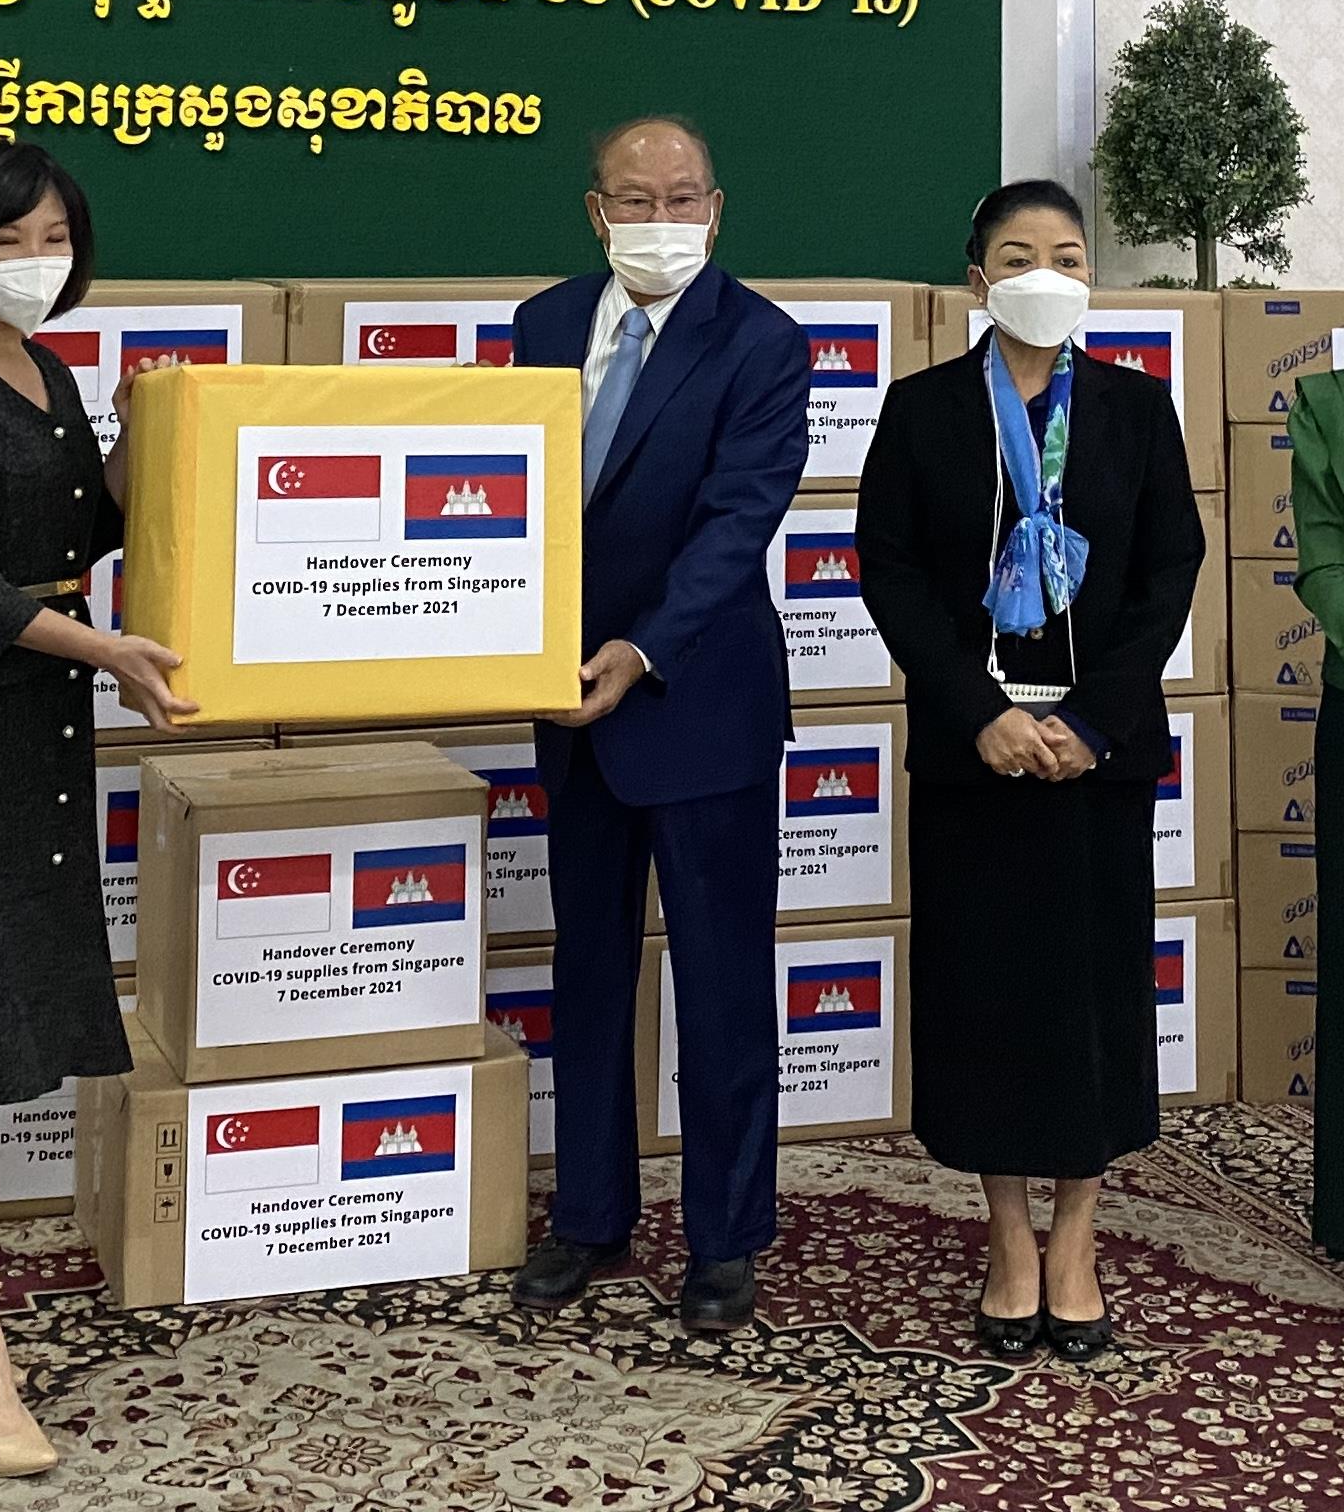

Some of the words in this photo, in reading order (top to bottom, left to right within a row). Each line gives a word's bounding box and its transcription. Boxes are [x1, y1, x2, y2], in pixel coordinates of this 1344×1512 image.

[818, 415, 878, 430] Singapore
[809, 435, 826, 444] 021
[306, 555, 387, 570] Handover
[390, 554, 472, 571] Ceremony
[252, 580, 328, 595] COVID-19
[332, 578, 400, 597] supplies
[404, 577, 443, 591] from
[447, 576, 527, 594] Singapore
[322, 604, 332, 617] 7
[336, 601, 419, 617] December
[422, 600, 458, 614] 2021
[777, 611, 836, 621] eremony
[785, 627, 815, 639] from
[818, 627, 877, 640] Singapore
[799, 645, 826, 657] 2021
[786, 846, 816, 858] from
[818, 844, 879, 858] Singapore
[495, 866, 547, 881] Singapo
[800, 863, 827, 876] 2021
[102, 876, 138, 886] erem
[121, 913, 136, 925] 20
[262, 945, 337, 961] Handover
[339, 939, 415, 955] Ceremony
[212, 969, 283, 986] COVID-19
[286, 964, 349, 983] supplies
[352, 962, 388, 975] from
[391, 956, 465, 974] Singapore
[277, 989, 286, 1003] 7
[290, 984, 366, 1001] December
[368, 980, 402, 995] 2021
[787, 1062, 817, 1075] from
[820, 1059, 881, 1074] Singapore
[800, 1079, 828, 1092] 2021
[13, 1109, 76, 1124] Handove
[35, 1126, 75, 1144] suppl
[26, 1150, 35, 1163] 7
[39, 1150, 73, 1161] Dece
[251, 1198, 325, 1215] Handover
[328, 1190, 404, 1207] Ceremony
[201, 1223, 271, 1241] COVID-19
[274, 1216, 337, 1236] supplies
[341, 1214, 377, 1227] from
[380, 1207, 454, 1224] Singapore
[265, 1243, 274, 1256] 7
[278, 1236, 355, 1255] December
[357, 1231, 390, 1246] 2021
